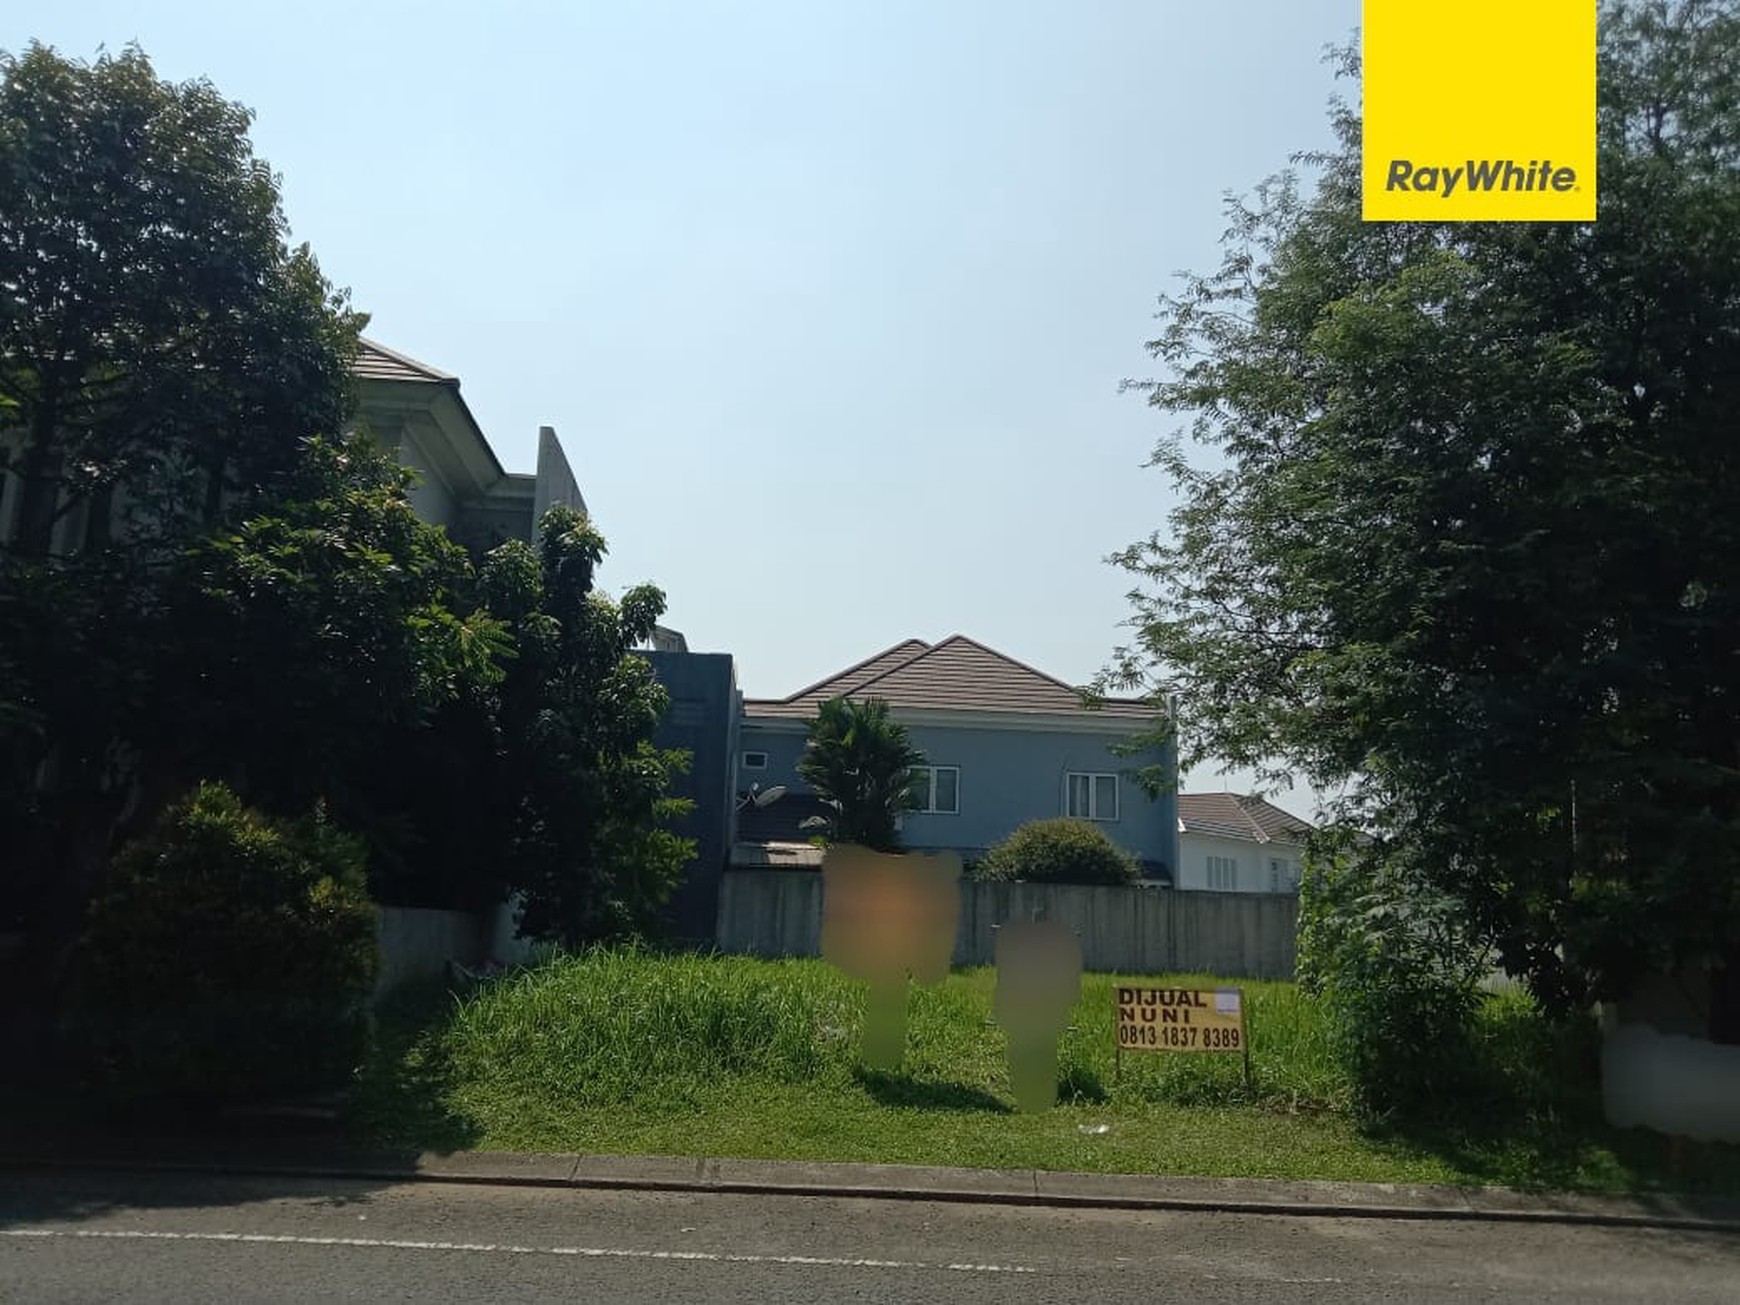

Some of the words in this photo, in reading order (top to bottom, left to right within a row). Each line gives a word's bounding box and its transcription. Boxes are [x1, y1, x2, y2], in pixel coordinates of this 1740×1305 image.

[1119, 988, 1207, 1008] DIJUAL
[1121, 1008, 1190, 1024] NUNI
[1120, 1025, 1156, 1045] 0813
[1162, 1027, 1197, 1046] 1837
[1203, 1028, 1239, 1048] 8389
